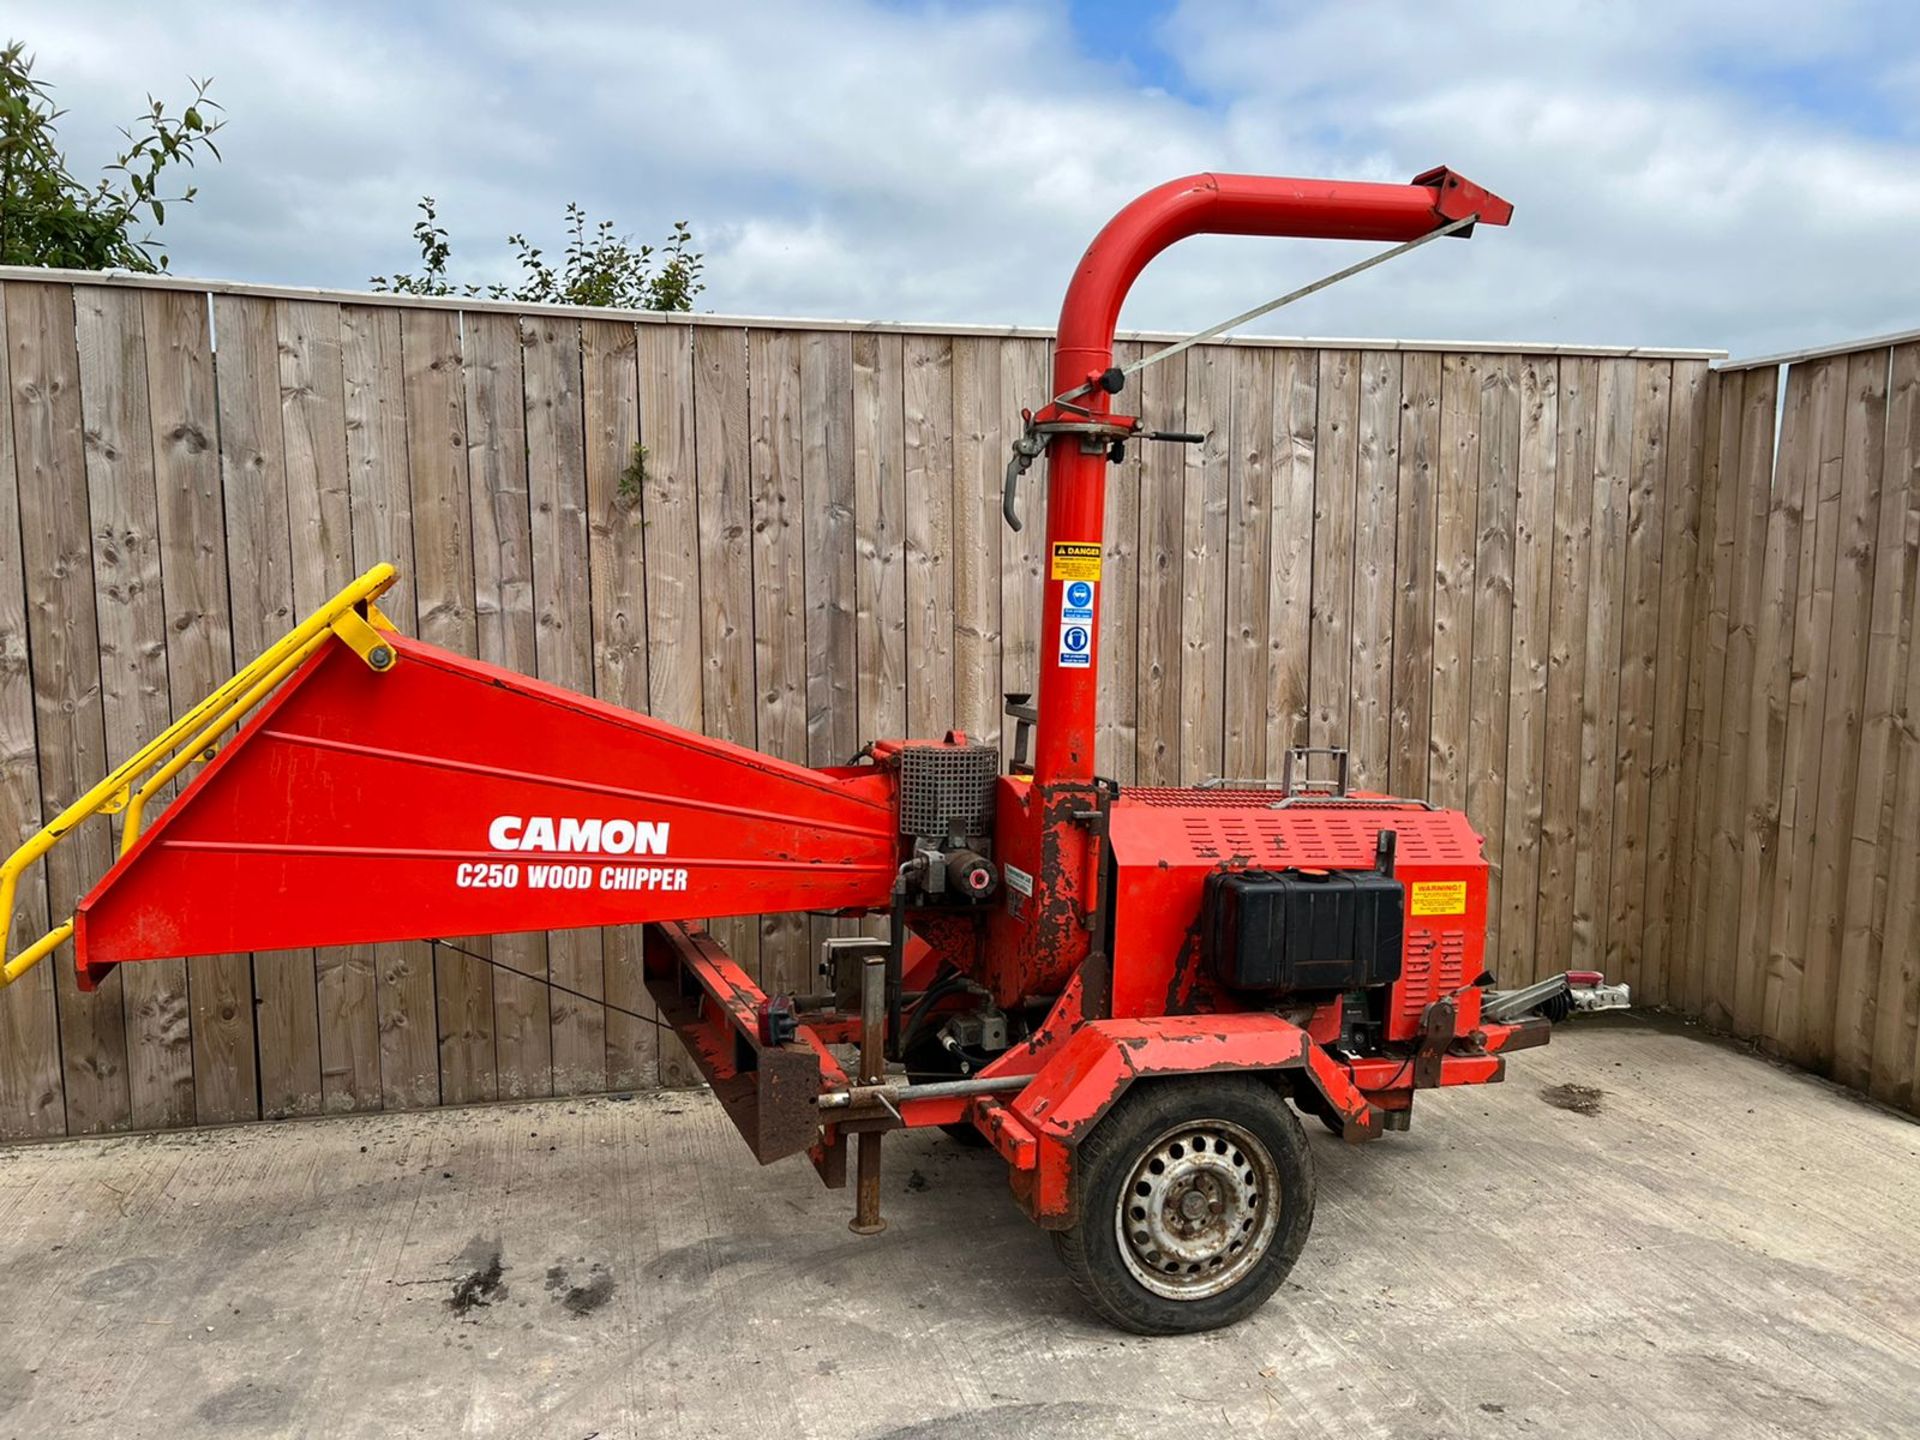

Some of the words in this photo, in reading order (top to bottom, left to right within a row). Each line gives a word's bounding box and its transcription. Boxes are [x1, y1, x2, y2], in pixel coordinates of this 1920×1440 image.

[488, 815, 670, 855] CAMON
[456, 863, 519, 888] C250
[527, 865, 593, 889] WOOD
[599, 866, 688, 890] CHIPPER
